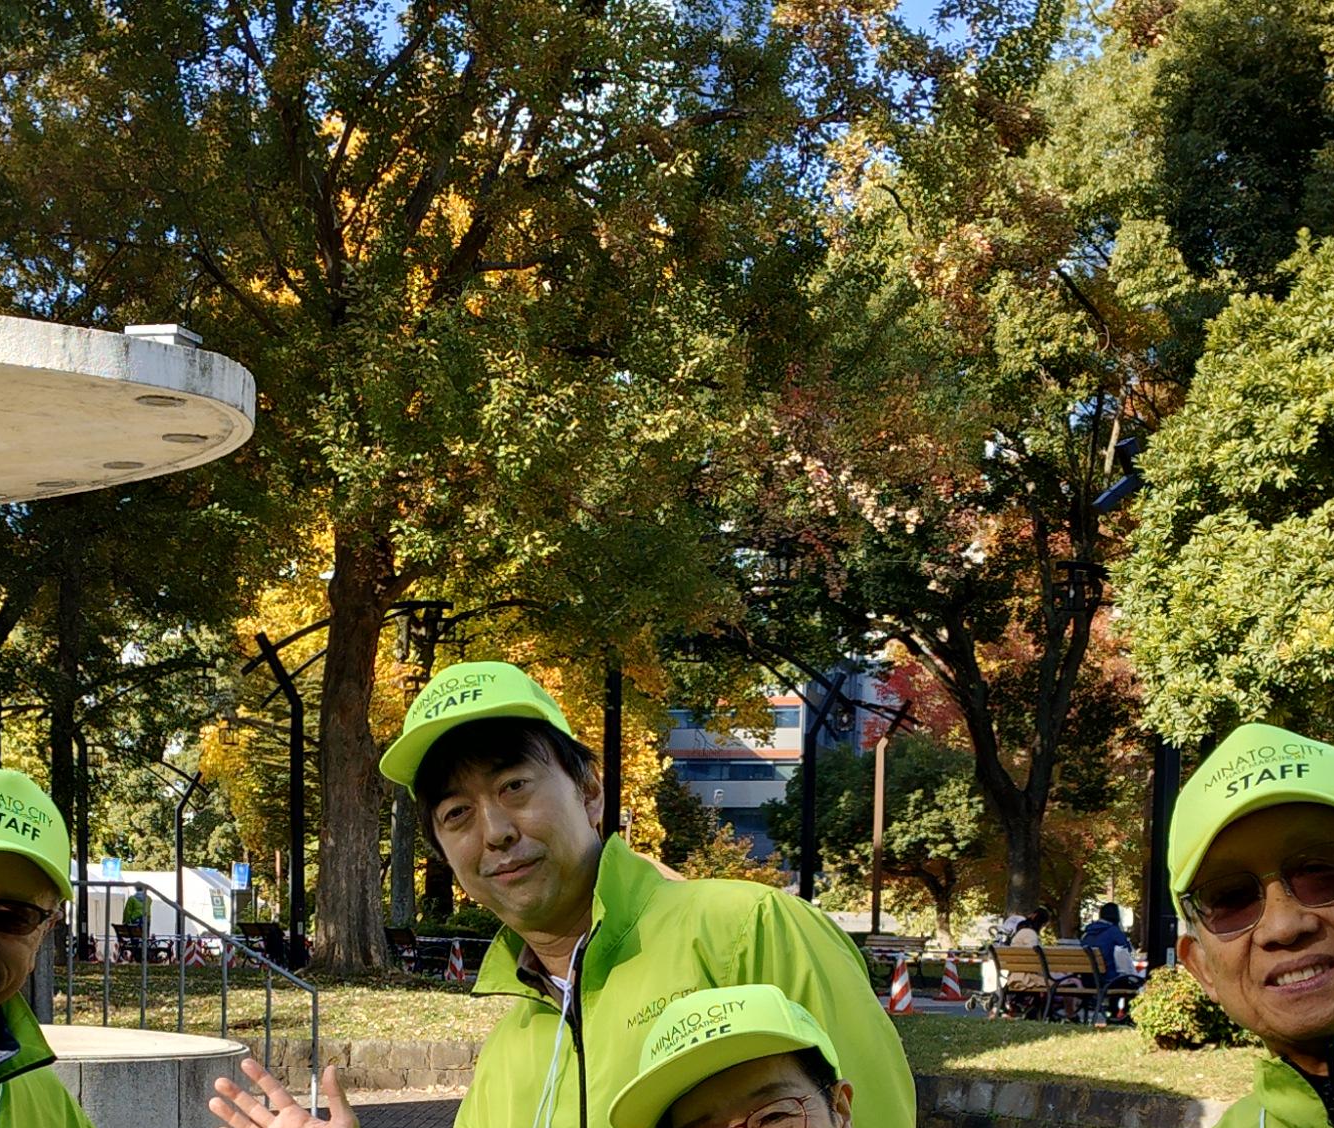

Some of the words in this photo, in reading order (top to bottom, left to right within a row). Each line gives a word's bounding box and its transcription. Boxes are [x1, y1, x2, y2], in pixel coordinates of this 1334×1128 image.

[464, 674, 497, 684] CITY
[1204, 746, 1276, 792] MINATO
[1283, 744, 1323, 756] CITY
[1225, 763, 1310, 798] STAFF
[28, 806, 53, 827] CITY
[650, 1013, 702, 1060] MINATO
[707, 1000, 745, 1017] CITY
